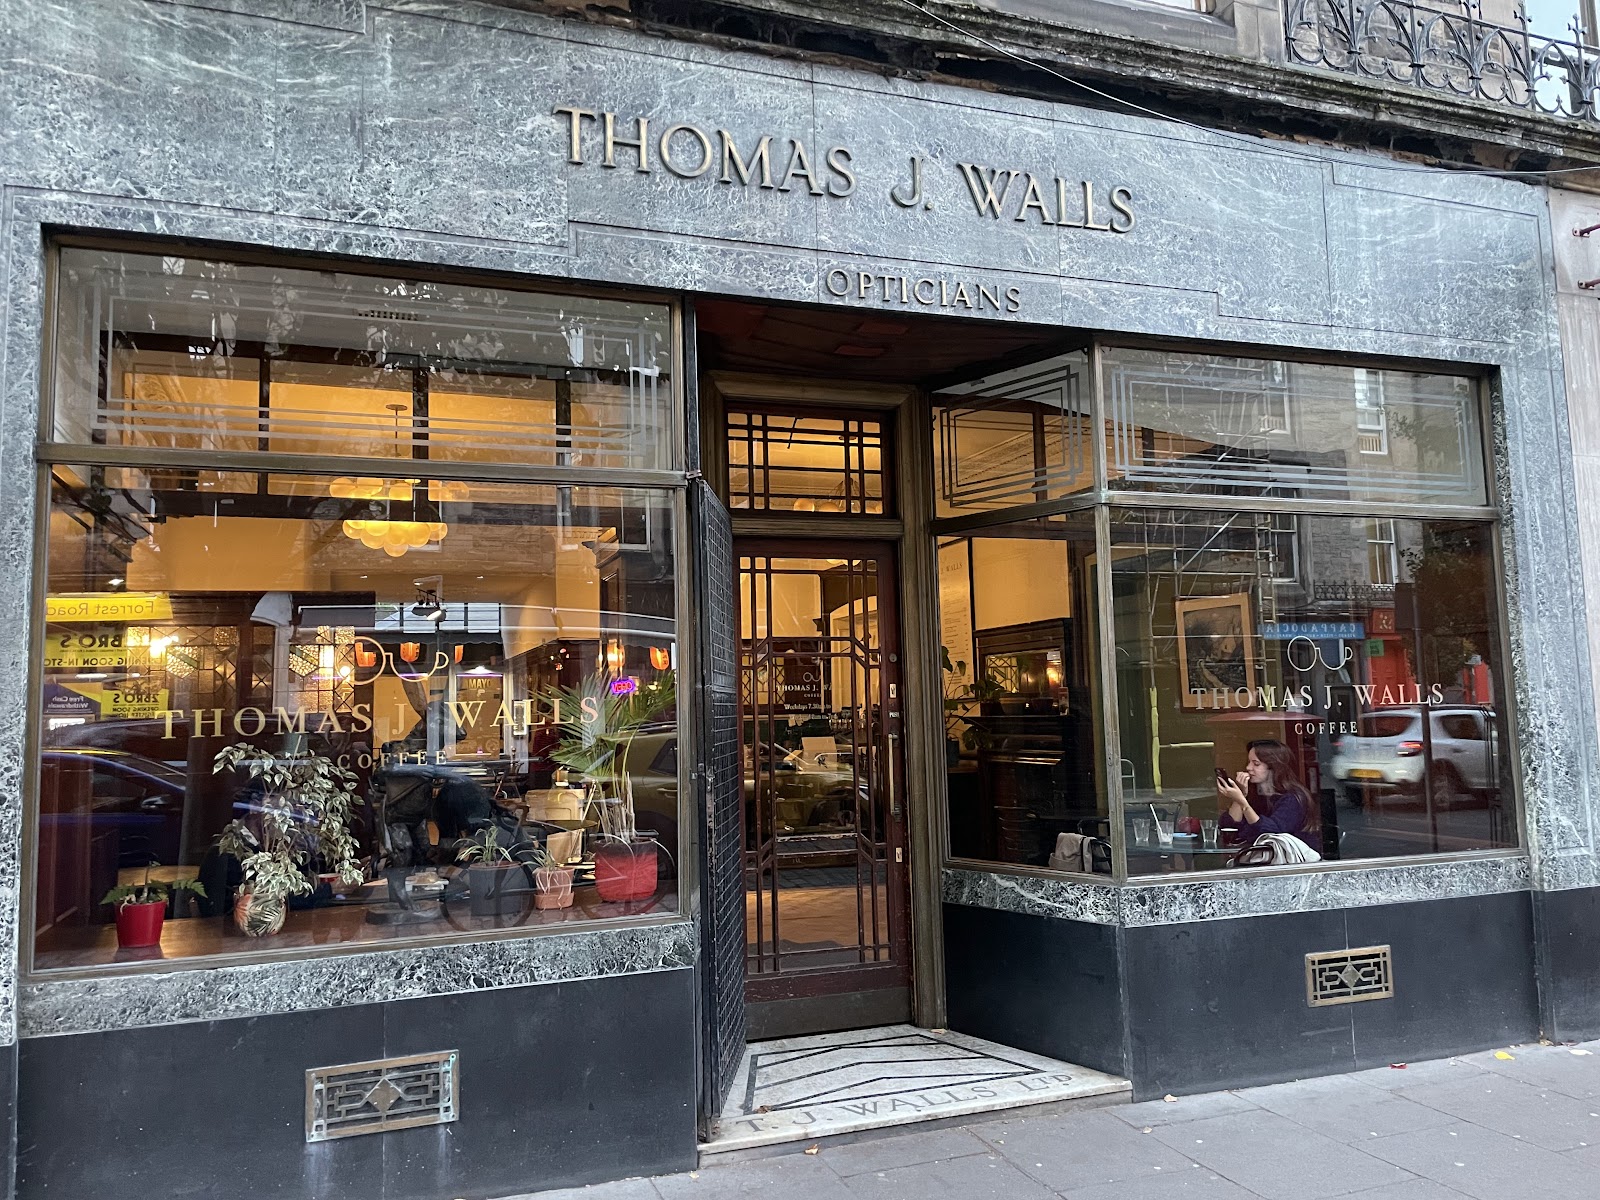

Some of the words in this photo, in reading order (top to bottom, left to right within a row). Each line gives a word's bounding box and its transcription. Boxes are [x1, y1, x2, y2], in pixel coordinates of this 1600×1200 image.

[552, 104, 858, 199] THOMAS
[890, 156, 934, 212] J.
[957, 162, 1137, 234] WALLS
[825, 267, 1023, 313] OPTICIANS
[776, 684, 811, 692] THOMAS
[1190, 685, 1313, 710] THOMAS
[1323, 684, 1343, 710] J.
[1352, 682, 1444, 706] WALLS
[154, 703, 372, 740] THOMAS
[444, 696, 600, 729] WALLS
[1294, 721, 1358, 735] COFFEE
[337, 750, 447, 769] COFFEE
[839, 1085, 998, 1117] WALLS
